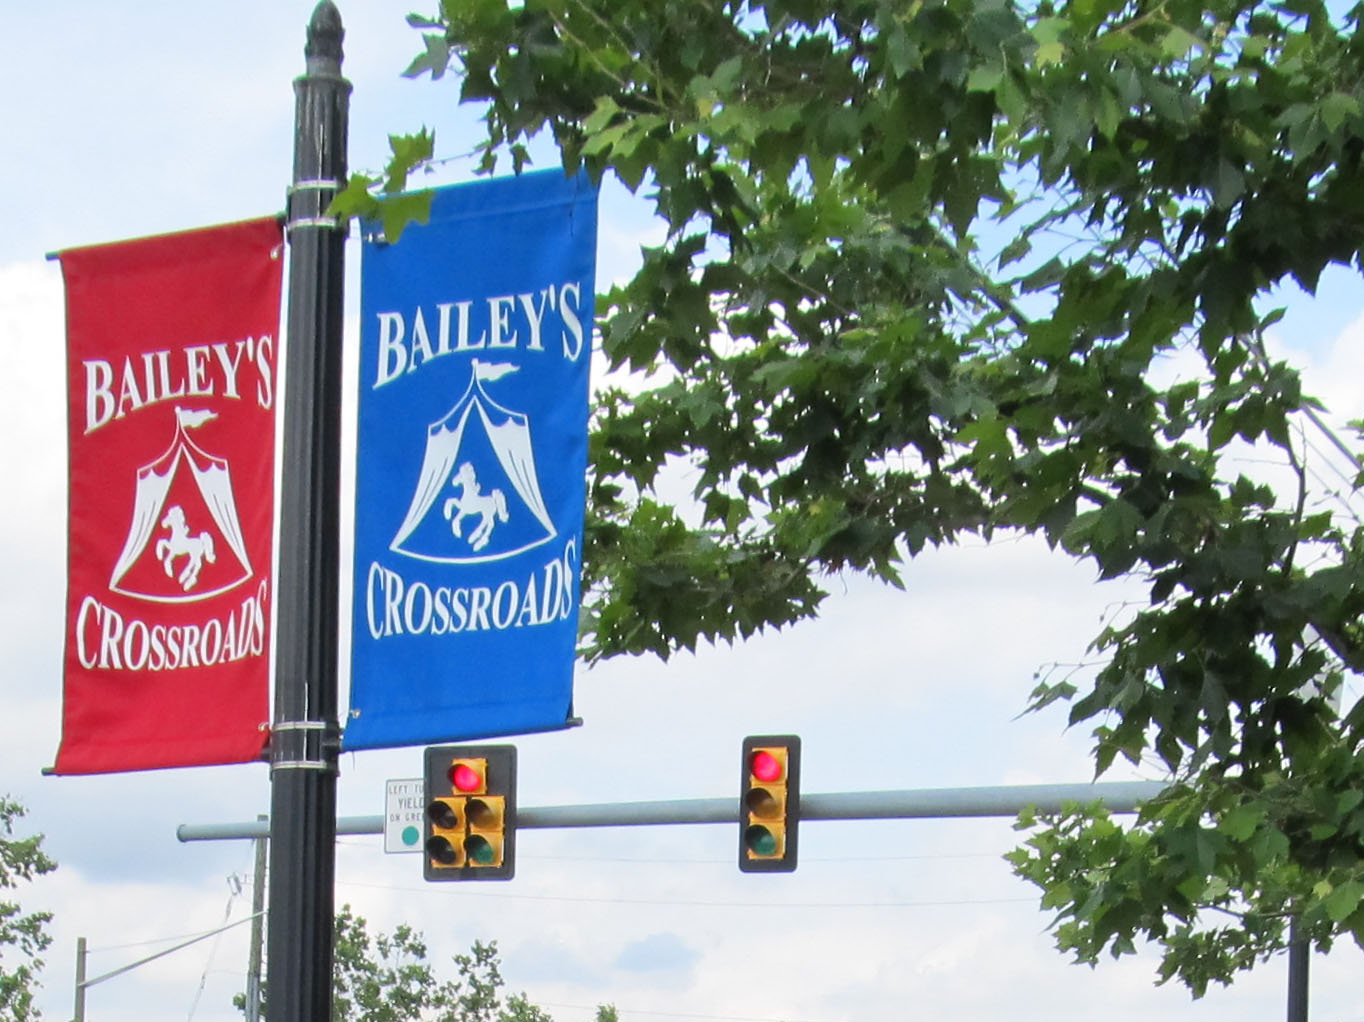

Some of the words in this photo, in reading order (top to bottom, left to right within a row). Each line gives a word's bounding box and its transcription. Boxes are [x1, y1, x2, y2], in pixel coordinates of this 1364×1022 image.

[373, 282, 584, 389] BAILEY'S
[83, 335, 273, 435] BAILEY'S
[77, 580, 267, 671] CROSSROADS
[367, 538, 576, 639] CROSSROADS
[389, 785, 408, 794] LEFT
[405, 813, 424, 821] GRE
